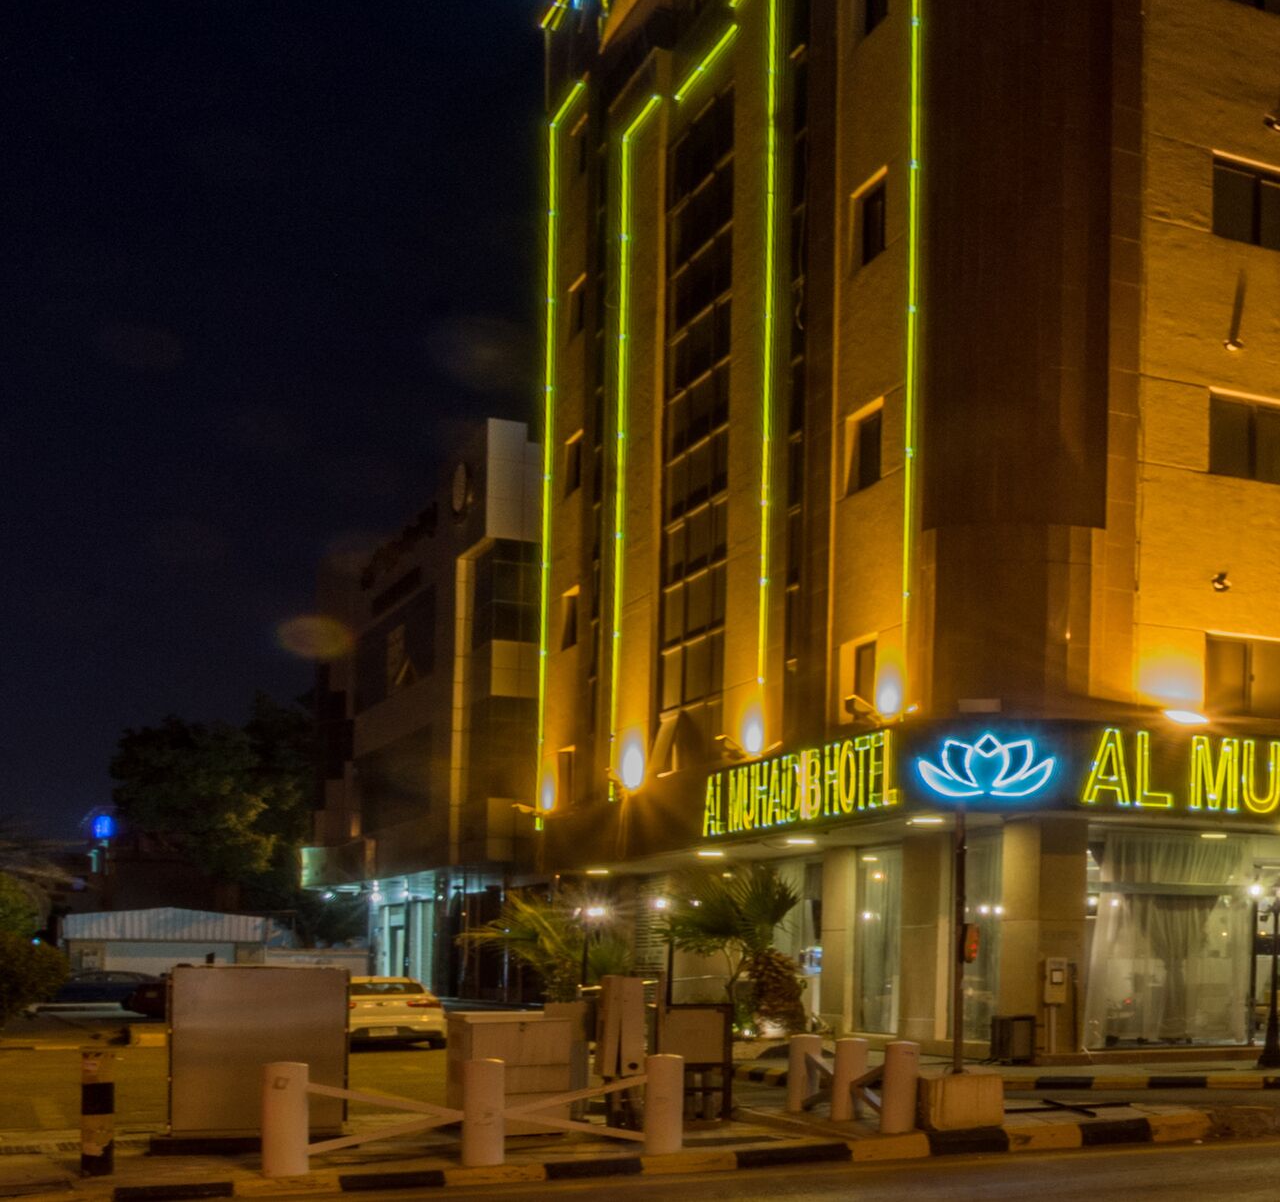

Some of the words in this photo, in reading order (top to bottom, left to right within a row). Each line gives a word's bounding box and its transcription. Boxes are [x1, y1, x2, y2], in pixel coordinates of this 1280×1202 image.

[703, 773, 722, 837] AL
[727, 747, 821, 834] MUHAIDIB
[823, 728, 898, 816] HOTEL
[1082, 727, 1173, 809] AL
